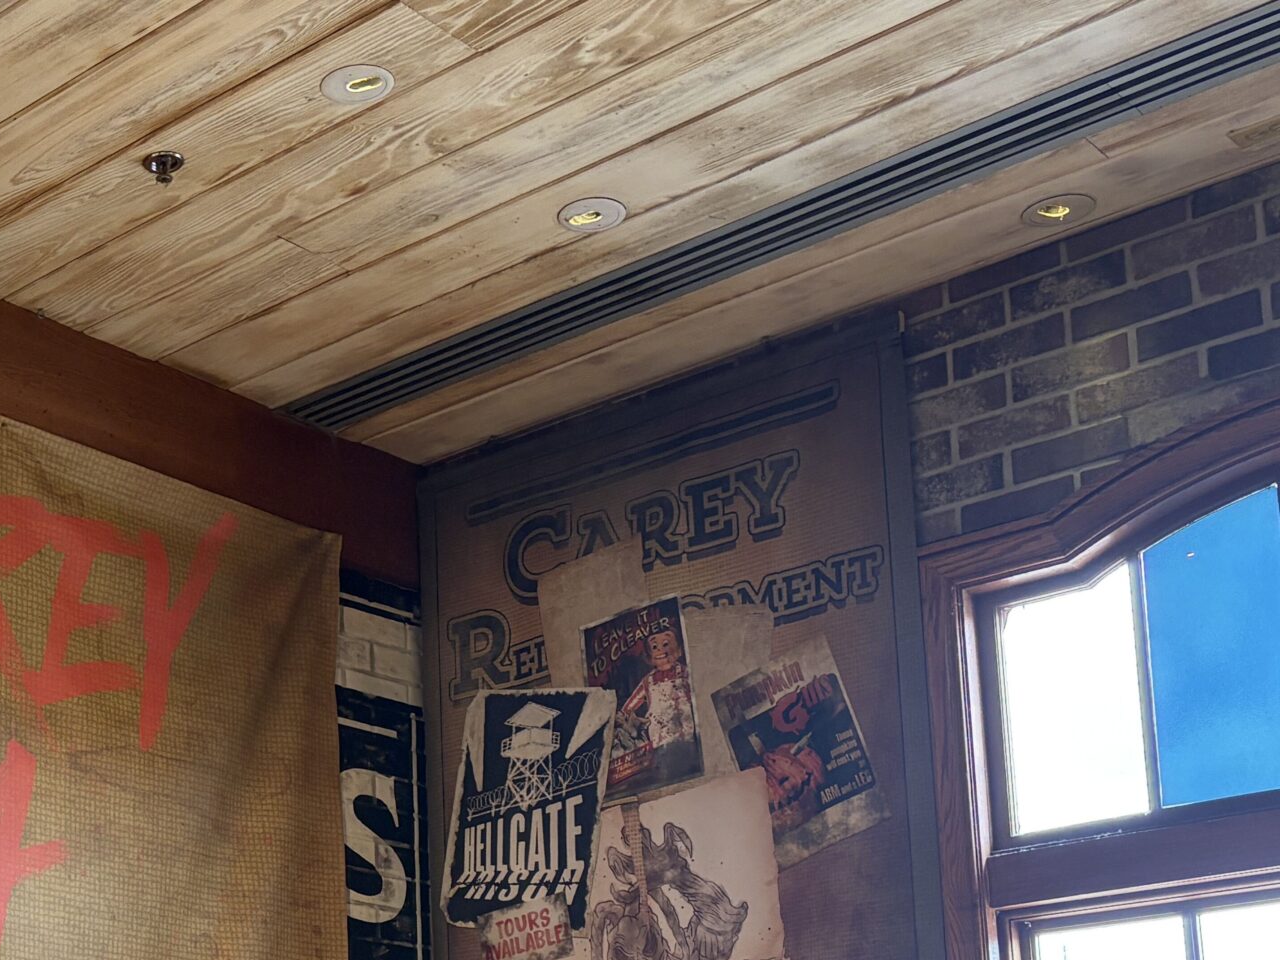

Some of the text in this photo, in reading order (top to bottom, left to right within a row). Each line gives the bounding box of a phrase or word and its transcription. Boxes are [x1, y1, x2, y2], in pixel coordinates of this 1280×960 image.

[637, 610, 650, 625] IT
[591, 617, 671, 677] TO CLEAVER
[820, 784, 841, 805] ARM
[463, 795, 584, 873] HELLGATE
[496, 908, 551, 939] TOURS
